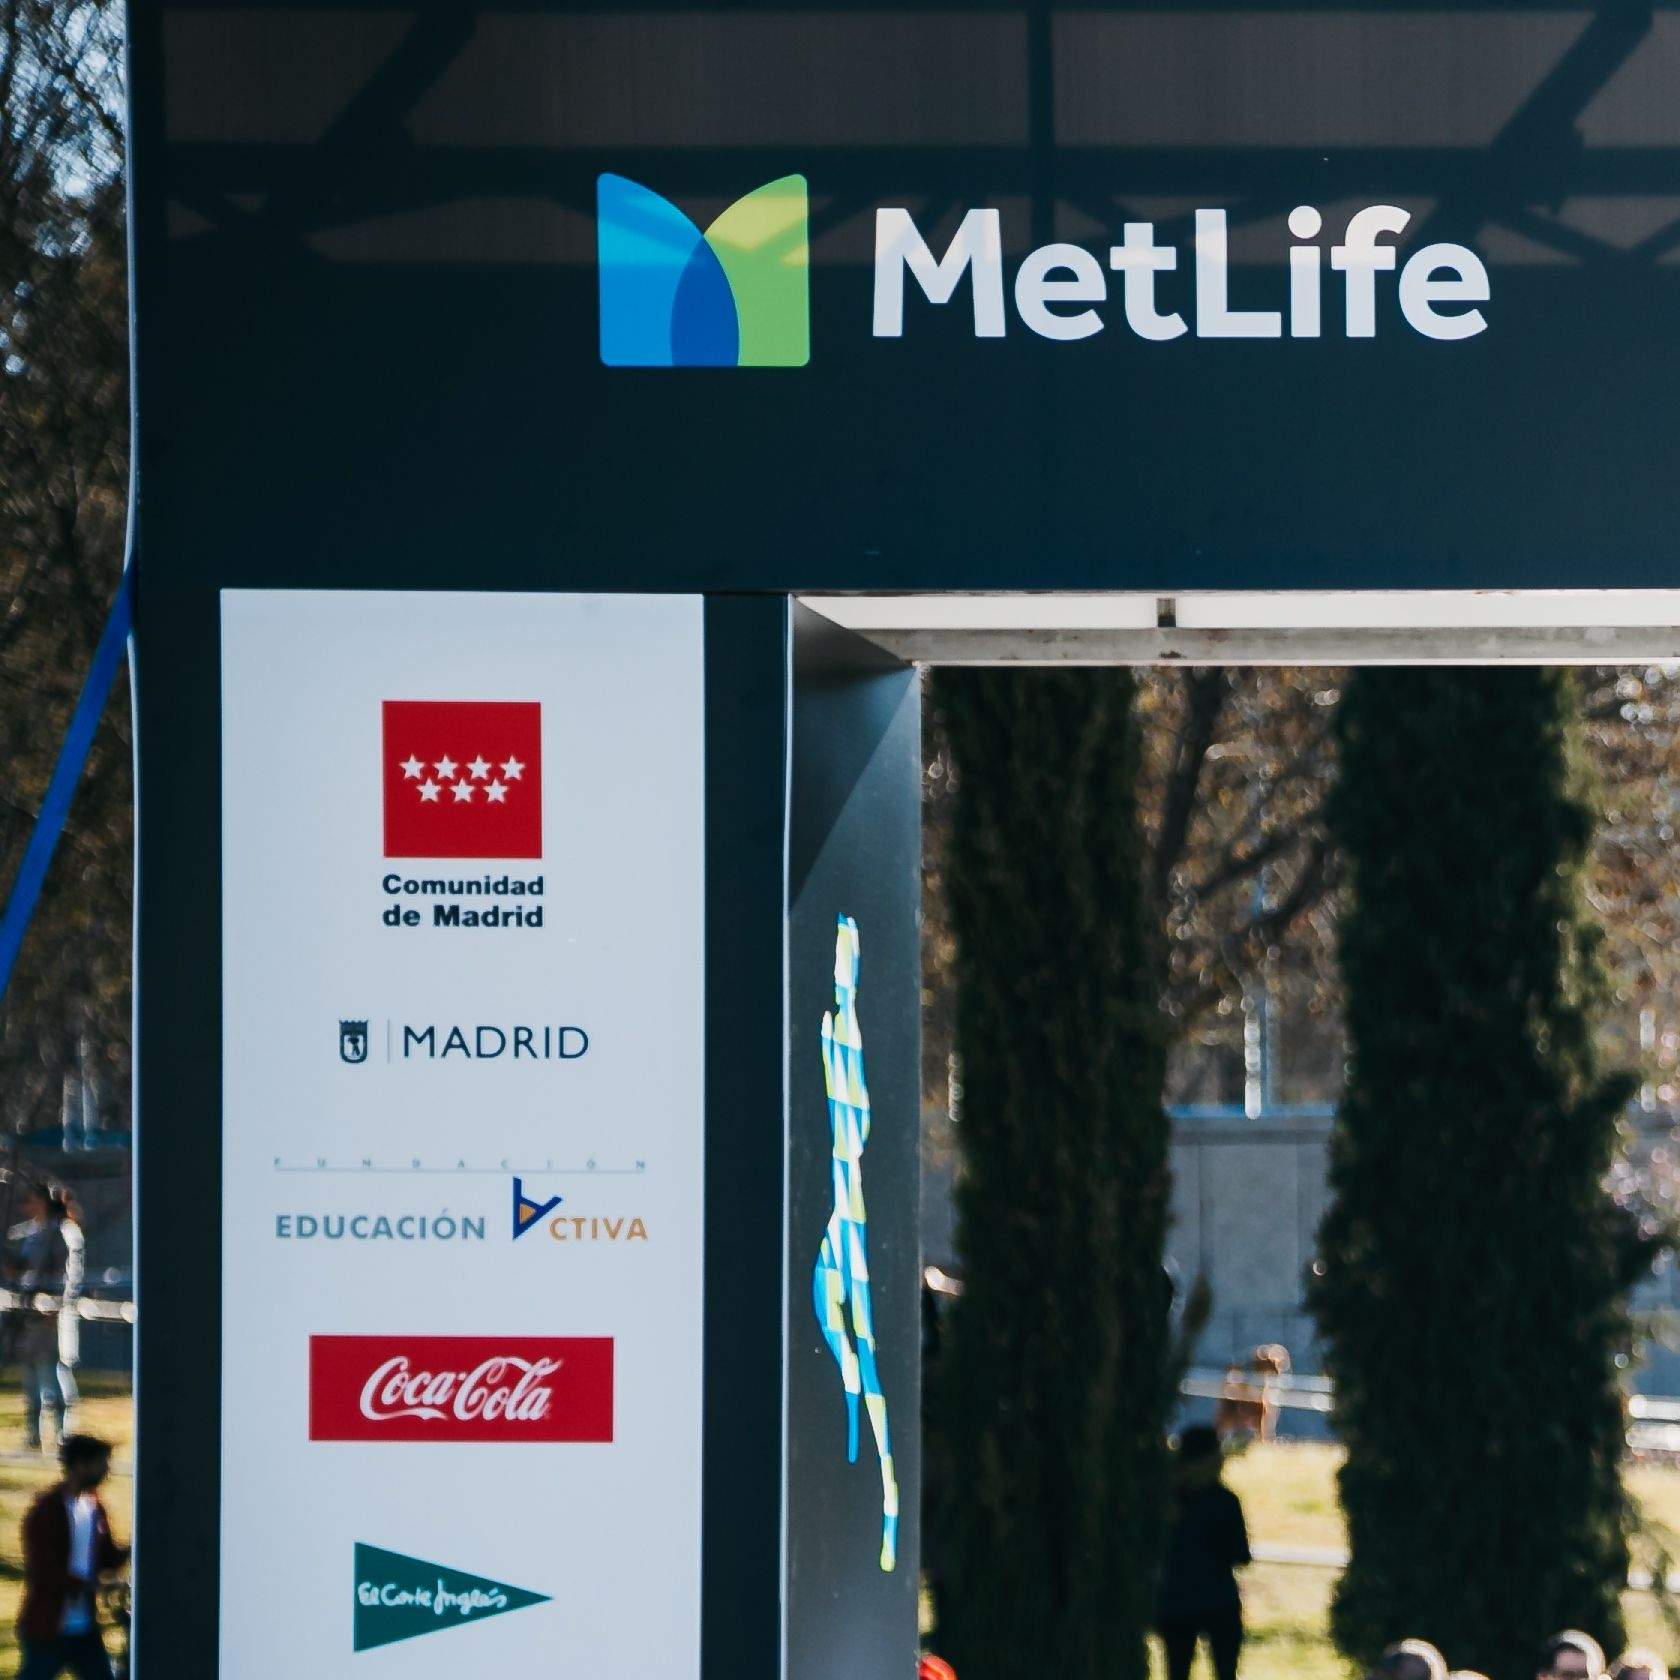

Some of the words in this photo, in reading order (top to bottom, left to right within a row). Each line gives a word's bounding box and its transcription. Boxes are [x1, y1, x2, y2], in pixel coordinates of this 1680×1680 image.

[872, 205, 1491, 341] MetLife
[382, 874, 544, 896] Comunidad
[382, 904, 421, 928] de
[433, 904, 544, 928] Madrid
[403, 1025, 590, 1060] MADRID
[275, 1208, 486, 1241] EDUCACIÓN
[357, 1581, 380, 1606] El
[380, 1583, 432, 1607] Corte
